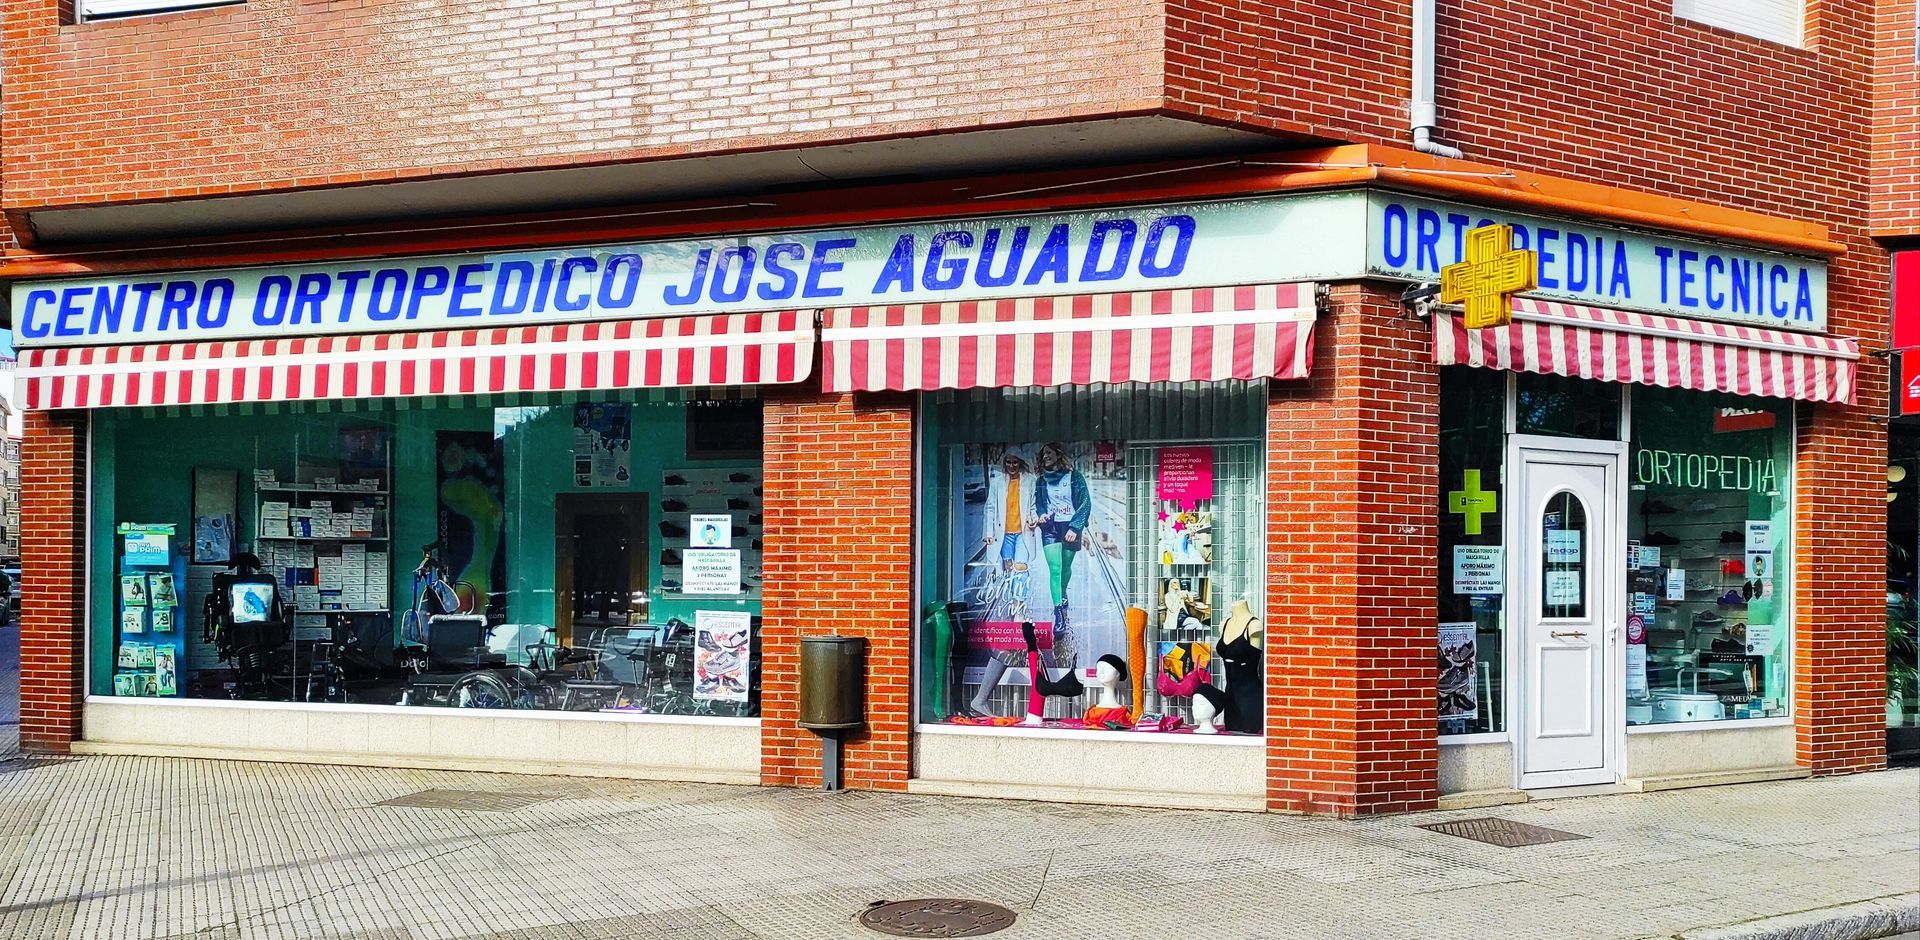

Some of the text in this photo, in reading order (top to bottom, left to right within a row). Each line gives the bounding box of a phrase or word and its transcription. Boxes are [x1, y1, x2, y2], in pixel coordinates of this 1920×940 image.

[21, 214, 1197, 339] CENTRO ORTOPEDICO JOSE AGUADO
[1655, 246, 1814, 322] TECNICA
[1637, 448, 1778, 493] ORTOPEDIA
